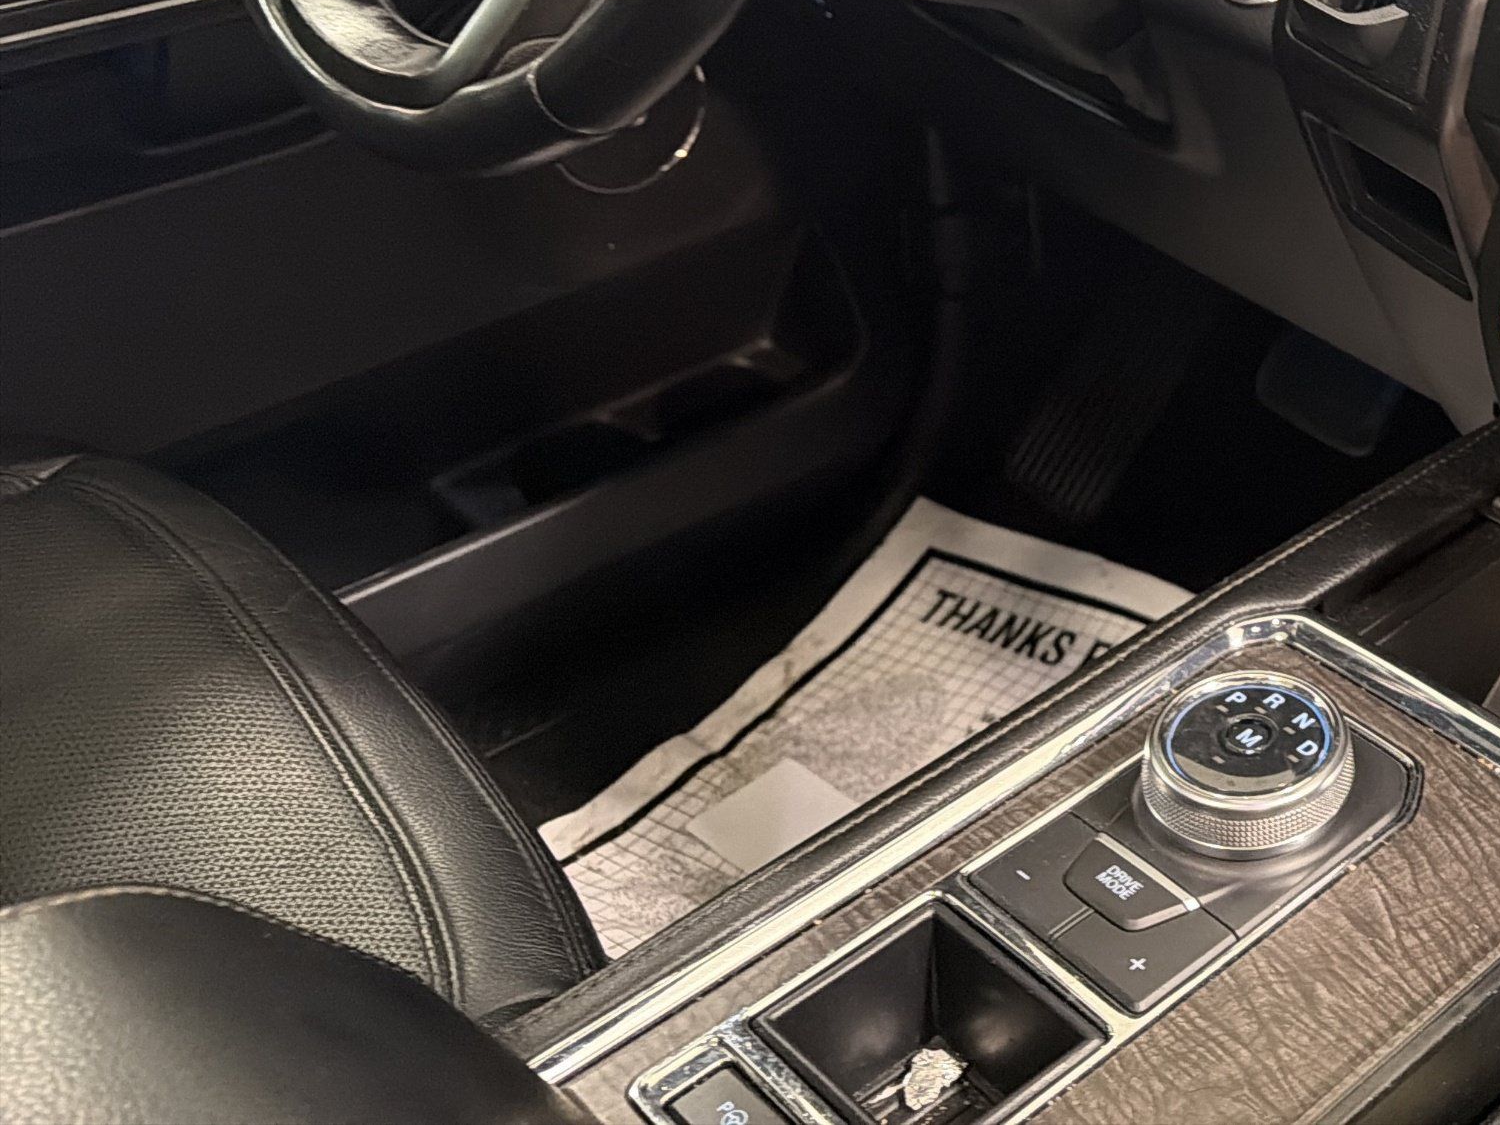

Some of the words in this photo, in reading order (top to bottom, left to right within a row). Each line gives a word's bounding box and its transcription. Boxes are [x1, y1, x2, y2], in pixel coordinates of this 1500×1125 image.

[919, 588, 1076, 666] THANKS
[1224, 691, 1248, 704] P
[1262, 693, 1287, 710] R
[1291, 712, 1317, 730] N
[1234, 727, 1264, 748] M
[1295, 739, 1319, 756] D
[1094, 871, 1131, 901] MODE
[1105, 864, 1144, 895] DRIVE
